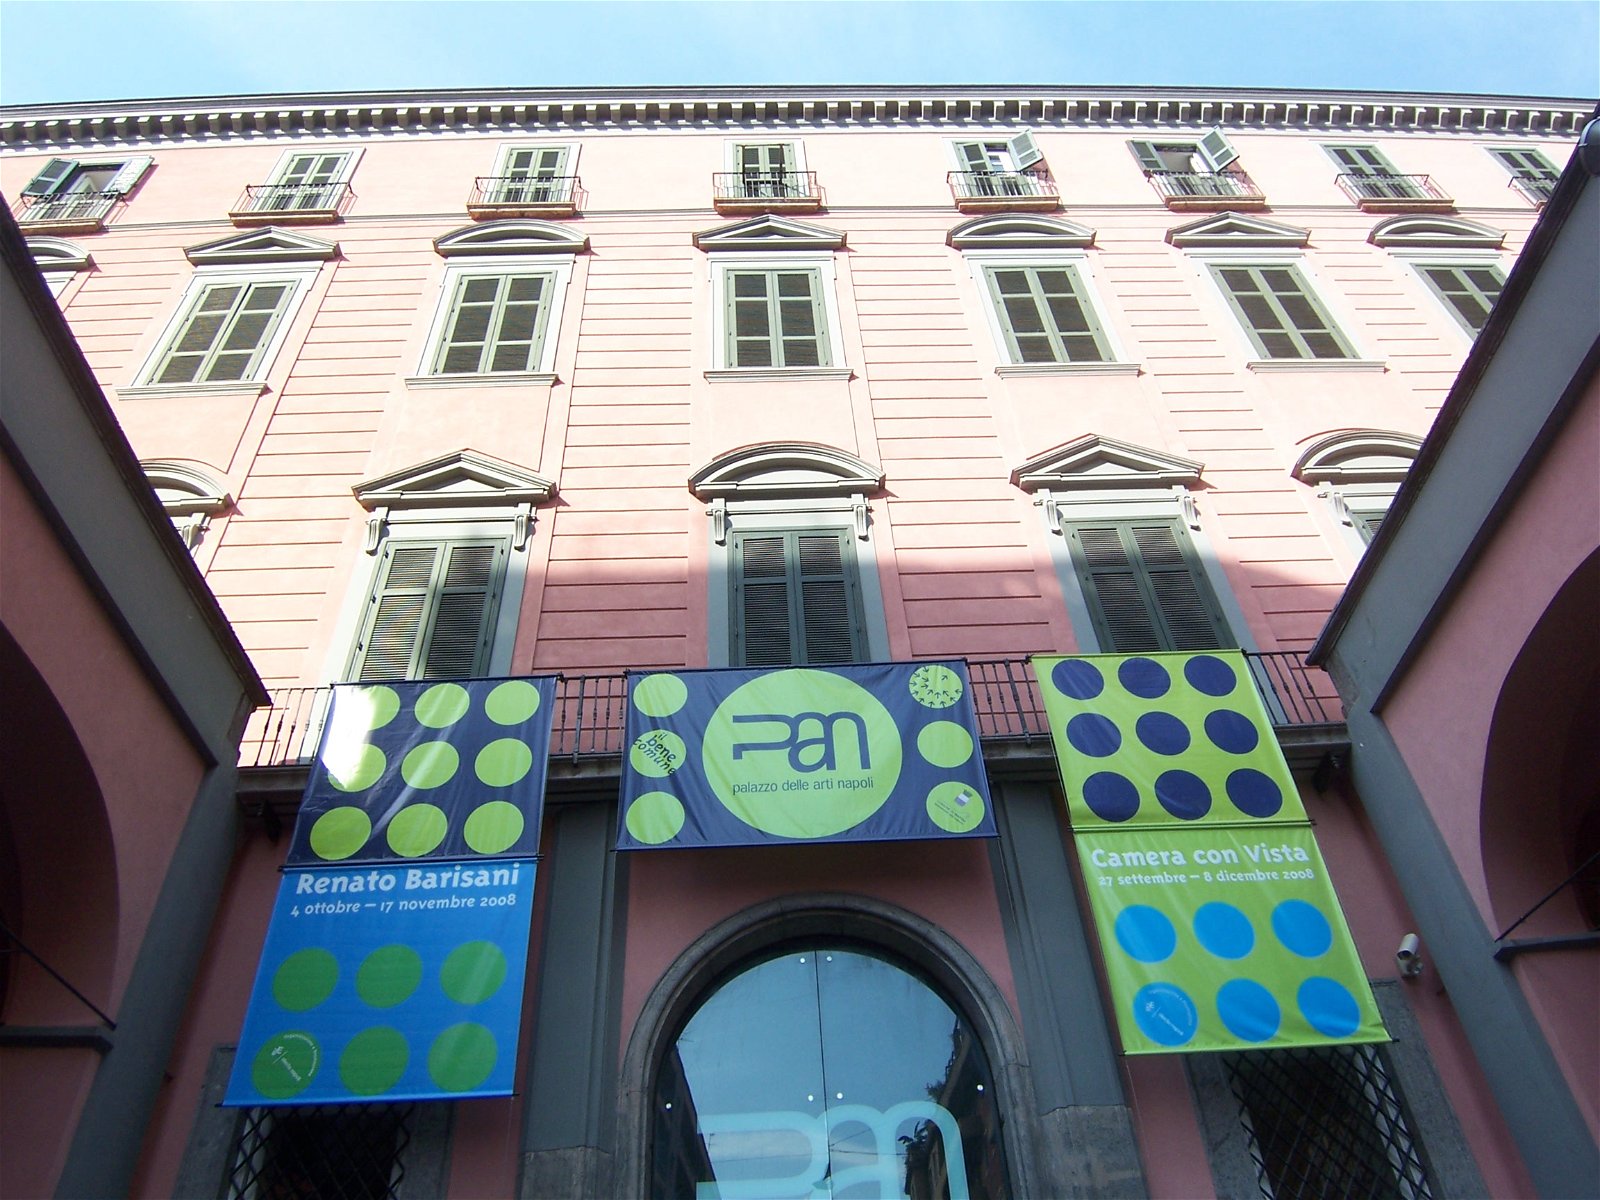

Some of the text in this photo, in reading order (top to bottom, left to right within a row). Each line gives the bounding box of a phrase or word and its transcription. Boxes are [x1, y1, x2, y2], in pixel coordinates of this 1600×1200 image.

[646, 734, 677, 763] bene
[657, 732, 668, 741] il
[633, 738, 677, 775] comune
[732, 777, 874, 796] palazzo delle arti napoli
[1092, 842, 1309, 868] Camera con Vista
[296, 862, 520, 894] Renato Barisani
[1099, 876, 1113, 887] 27
[1118, 871, 1187, 885] settembre
[1203, 871, 1213, 882] 8
[1216, 869, 1280, 881] dicembre
[1283, 868, 1314, 880] 2008
[291, 905, 300, 917] 4
[304, 900, 360, 915] ottobre
[380, 901, 394, 913] 17
[399, 895, 475, 910] novembre
[480, 893, 516, 907] 2008
